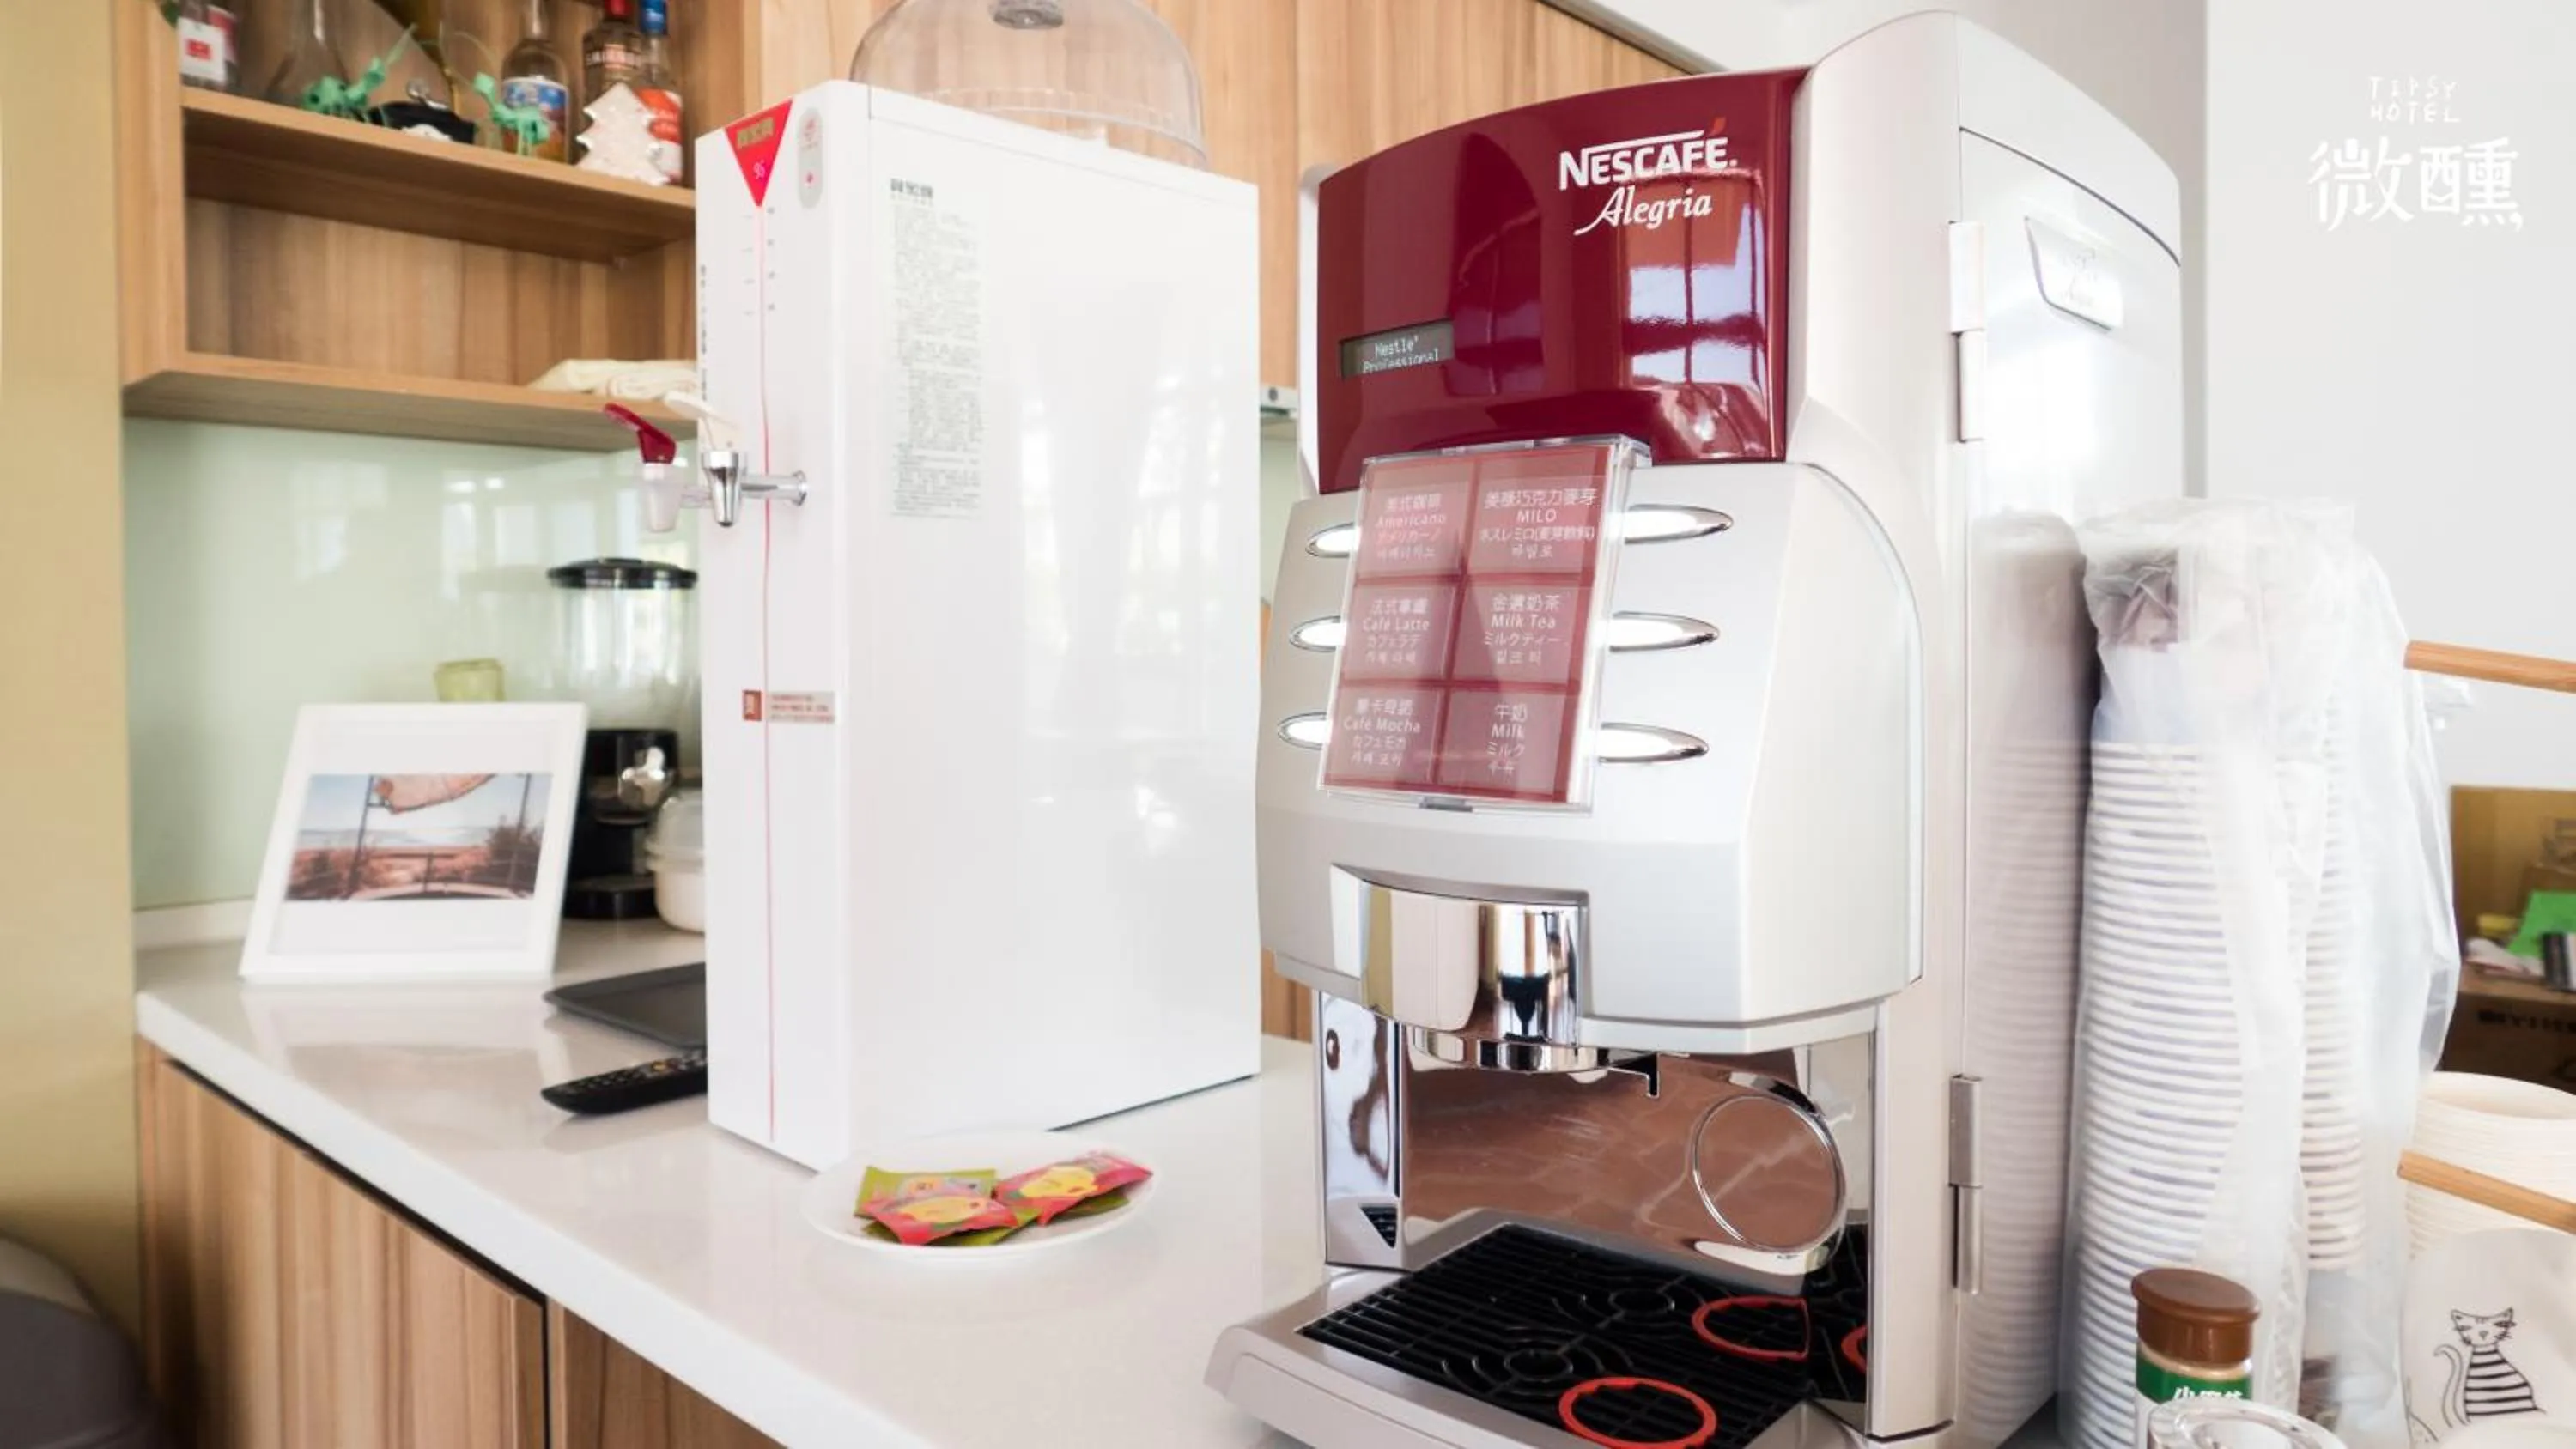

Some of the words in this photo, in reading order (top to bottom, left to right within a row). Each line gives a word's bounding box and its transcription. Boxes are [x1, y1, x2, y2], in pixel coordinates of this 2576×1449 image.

[1573, 184, 1713, 236] Alegria
[1376, 513, 1447, 529] Americano
[1517, 507, 1557, 523] MILO
[1395, 617, 1430, 631] Latte
[1491, 613, 1522, 628] Milk
[1531, 613, 1556, 629] Tea
[1376, 718, 1421, 733] Mocha
[1491, 722, 1526, 739] Milk
